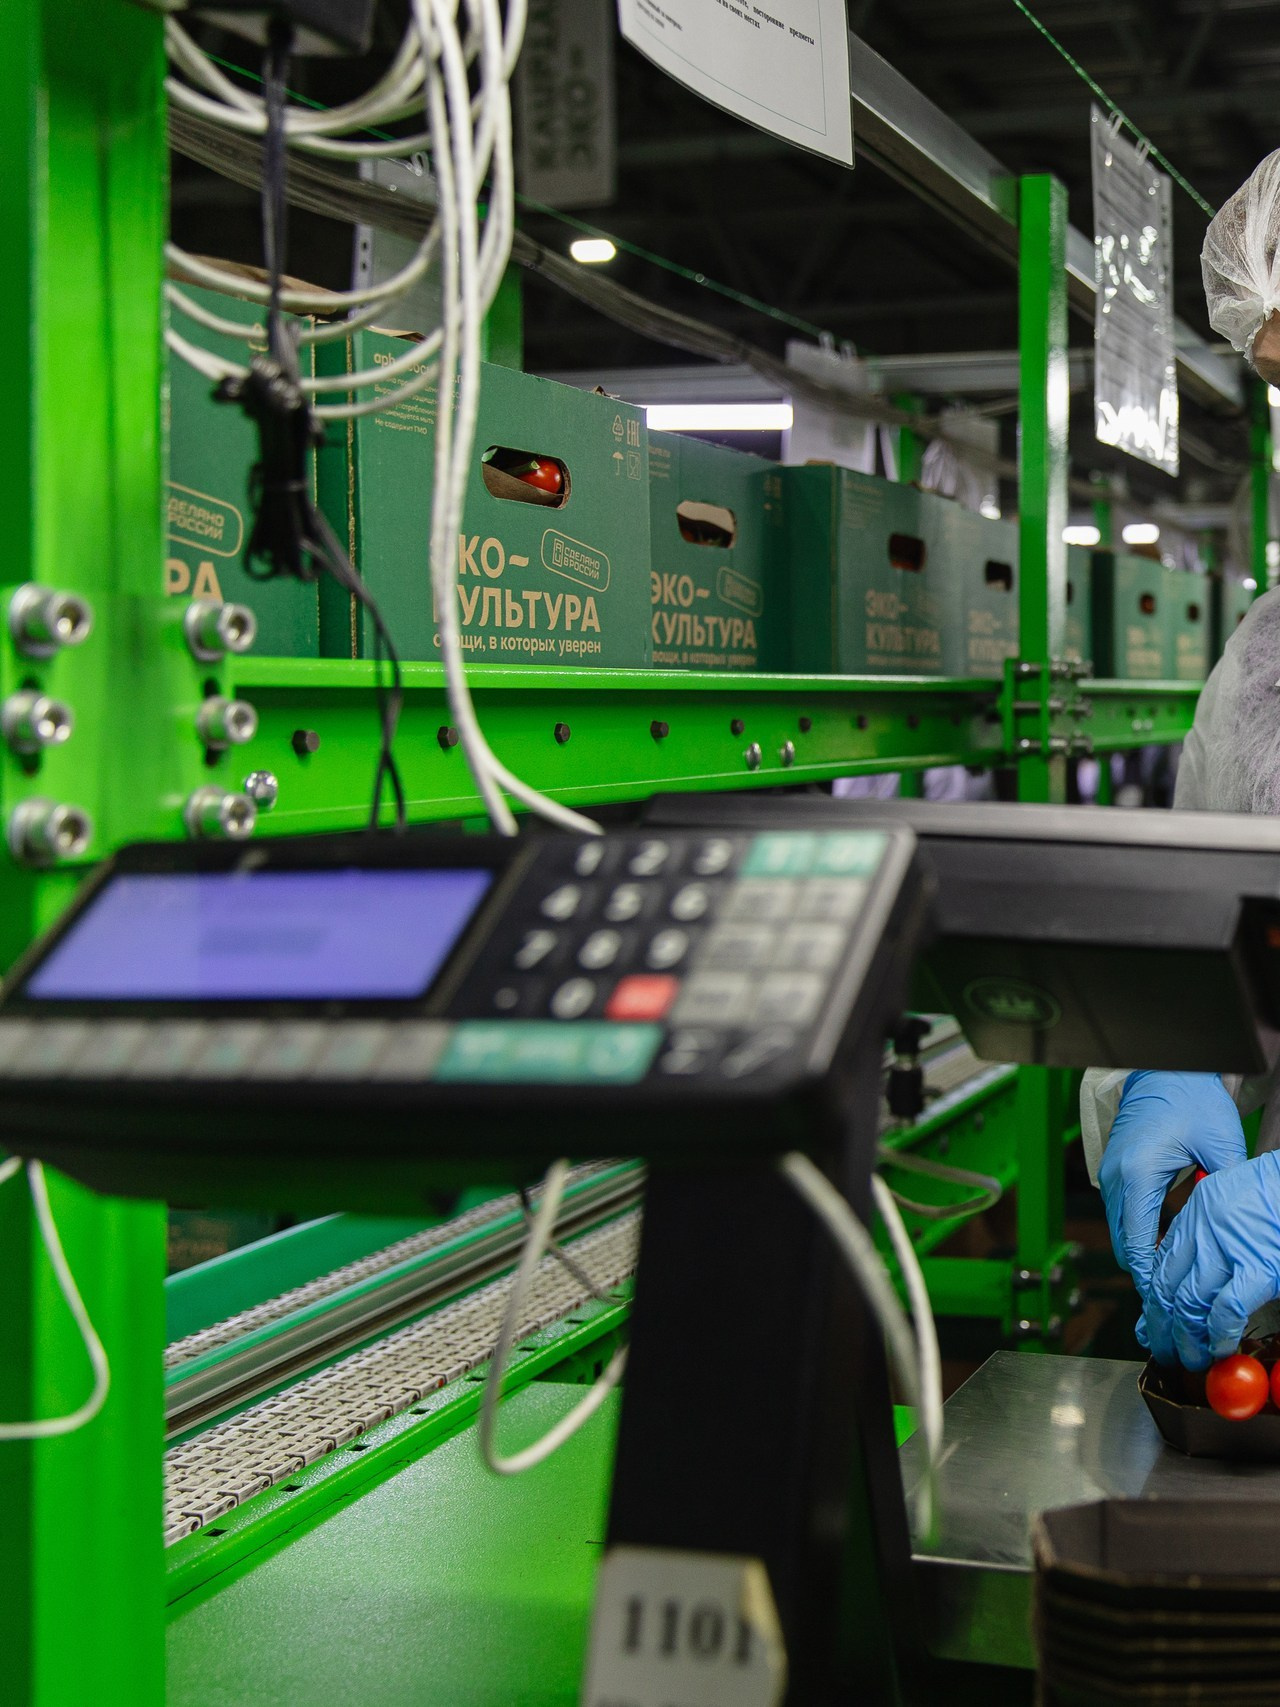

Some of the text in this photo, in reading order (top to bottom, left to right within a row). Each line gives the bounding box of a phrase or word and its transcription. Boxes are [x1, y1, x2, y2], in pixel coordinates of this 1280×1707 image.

[167, 498, 225, 527] ДЕЛАНО
[457, 534, 529, 579] КО-
[564, 546, 600, 570] СДЕЛАНО
[433, 584, 601, 633] УЛЬТУРА
[489, 636, 498, 650] в
[500, 636, 556, 657] которых
[558, 639, 601, 658] уверен
